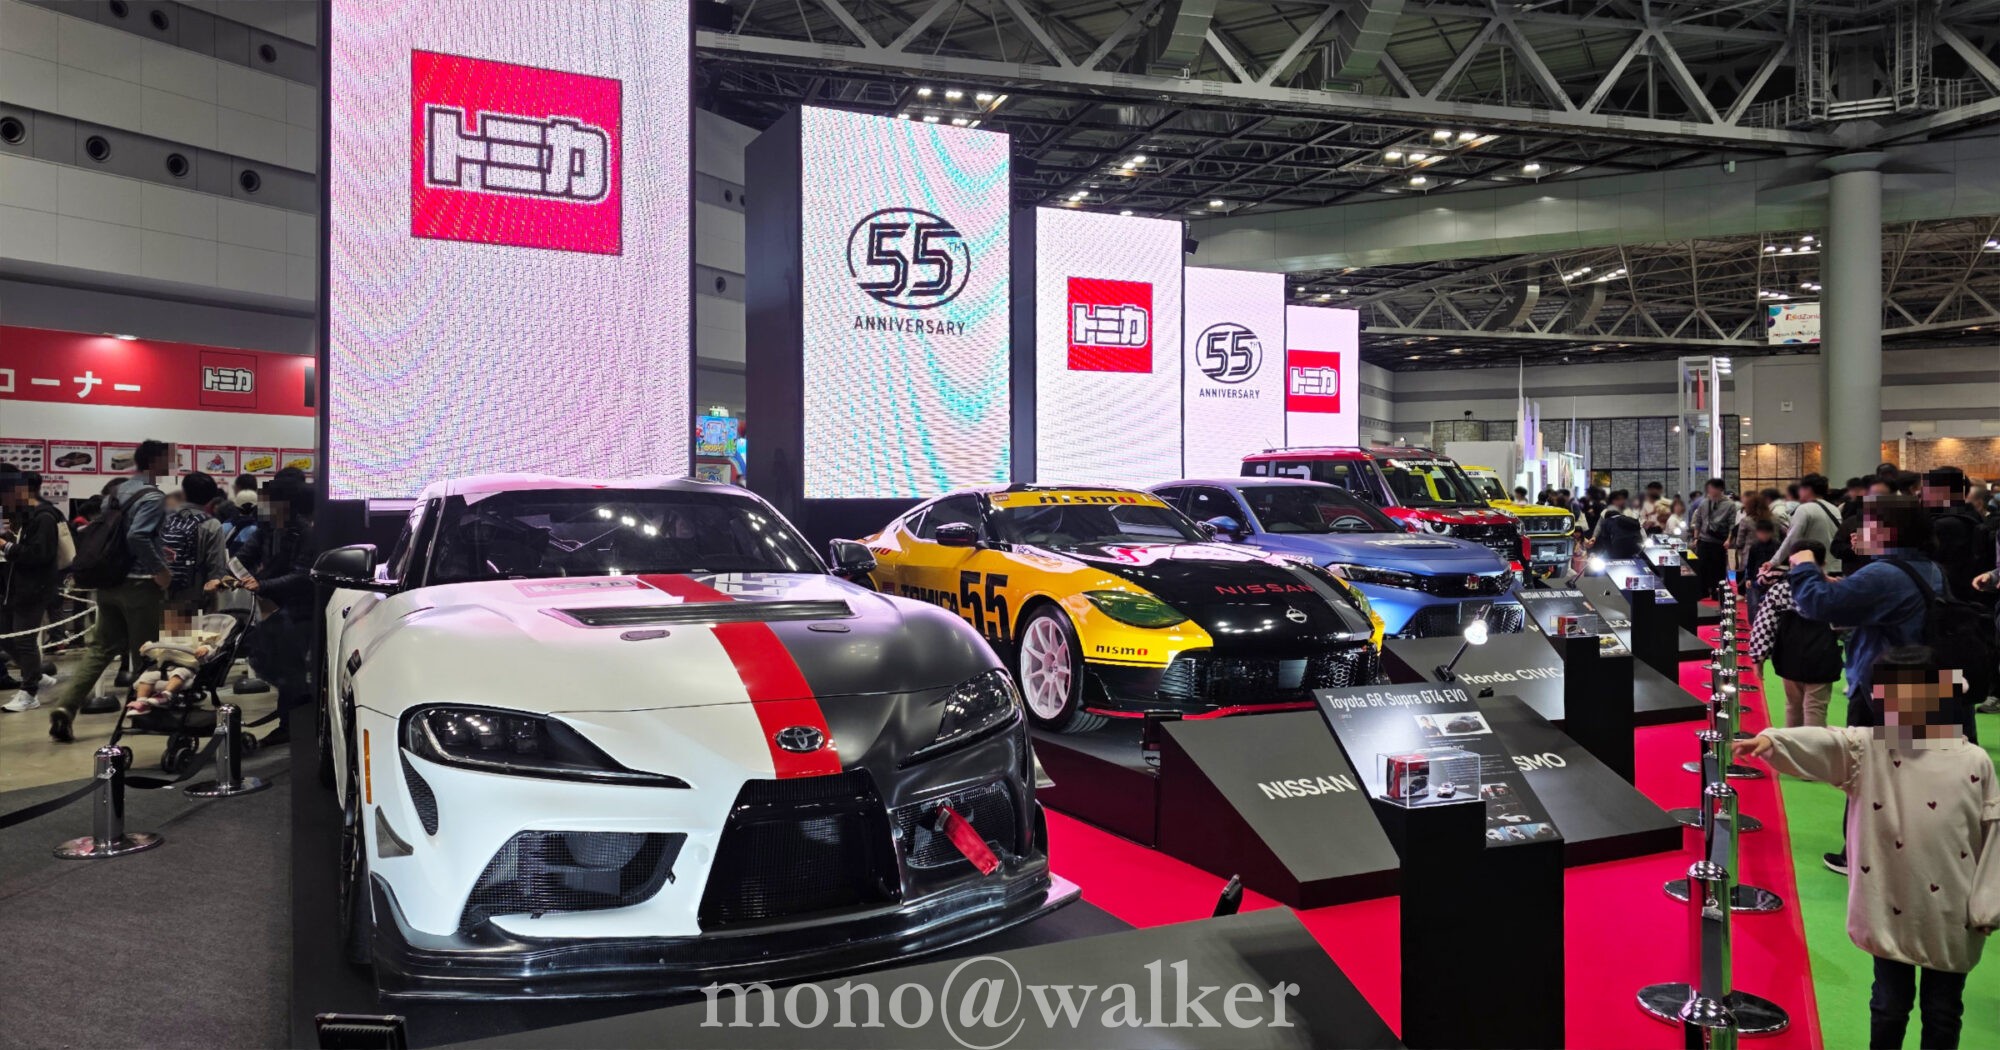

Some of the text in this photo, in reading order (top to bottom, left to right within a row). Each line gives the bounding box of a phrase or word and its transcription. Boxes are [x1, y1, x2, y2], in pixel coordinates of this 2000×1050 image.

[425, 104, 610, 202] トミカ
[854, 315, 966, 336] ANNIVERSARY
[1072, 304, 1148, 347] トミカ
[203, 366, 254, 394] トミカ
[1290, 366, 1339, 397] トミカ
[1199, 387, 1260, 400] ANNIVERSARY
[1215, 583, 1314, 596] NISSAN
[960, 569, 1014, 644] 55
[1457, 666, 1563, 685] Honda CIVIC
[1326, 688, 1468, 712] Toyota GR Supra GT4 EVO
[1257, 774, 1358, 800] NISSAN
